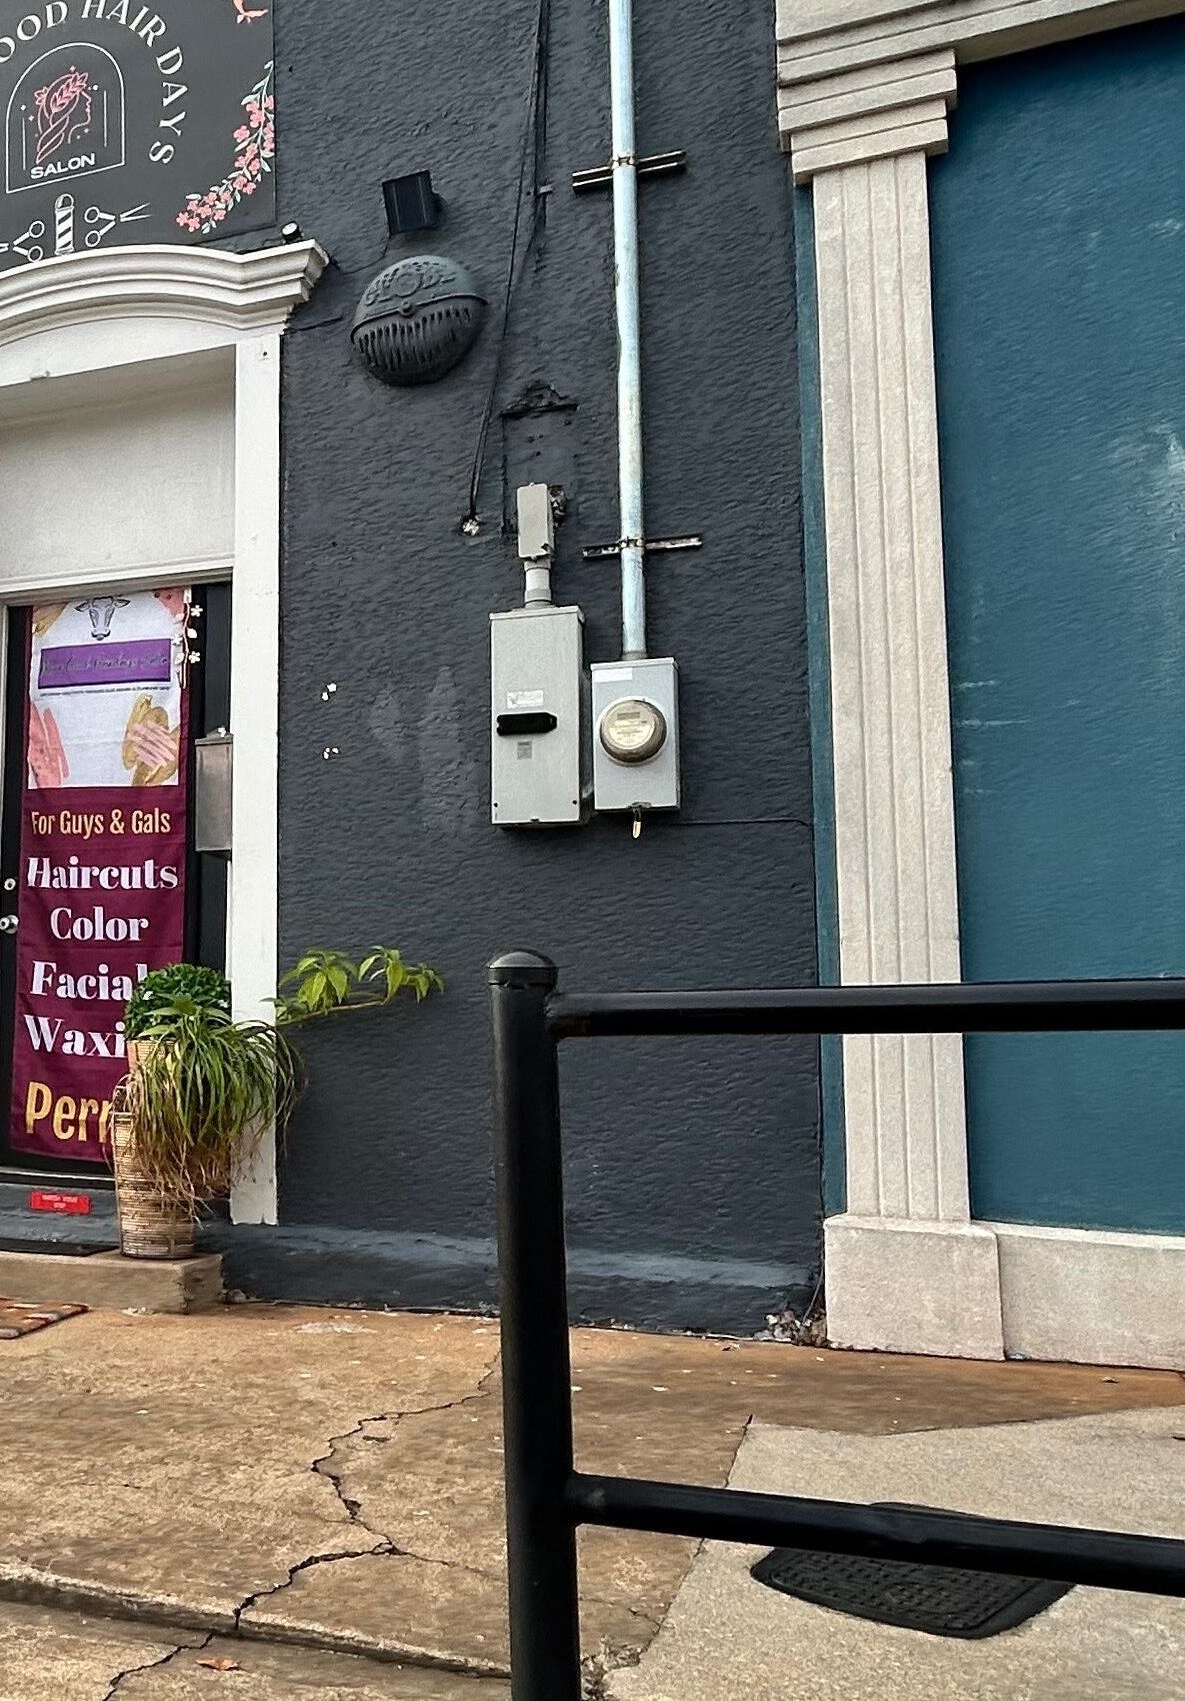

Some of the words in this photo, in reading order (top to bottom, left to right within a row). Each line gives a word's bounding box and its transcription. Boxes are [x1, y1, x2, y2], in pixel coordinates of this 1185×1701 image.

[80, 0, 168, 48] HAIR
[150, 46, 189, 166] DAYS
[29, 152, 97, 181] SALON
[30, 811, 56, 836] For
[59, 810, 104, 840] Guys
[110, 810, 126, 835] &
[131, 808, 172, 835] Gals
[26, 855, 179, 891] Haircuts
[49, 906, 150, 942] Color
[29, 960, 152, 1002] Facial
[23, 1013, 128, 1059] Waxi
